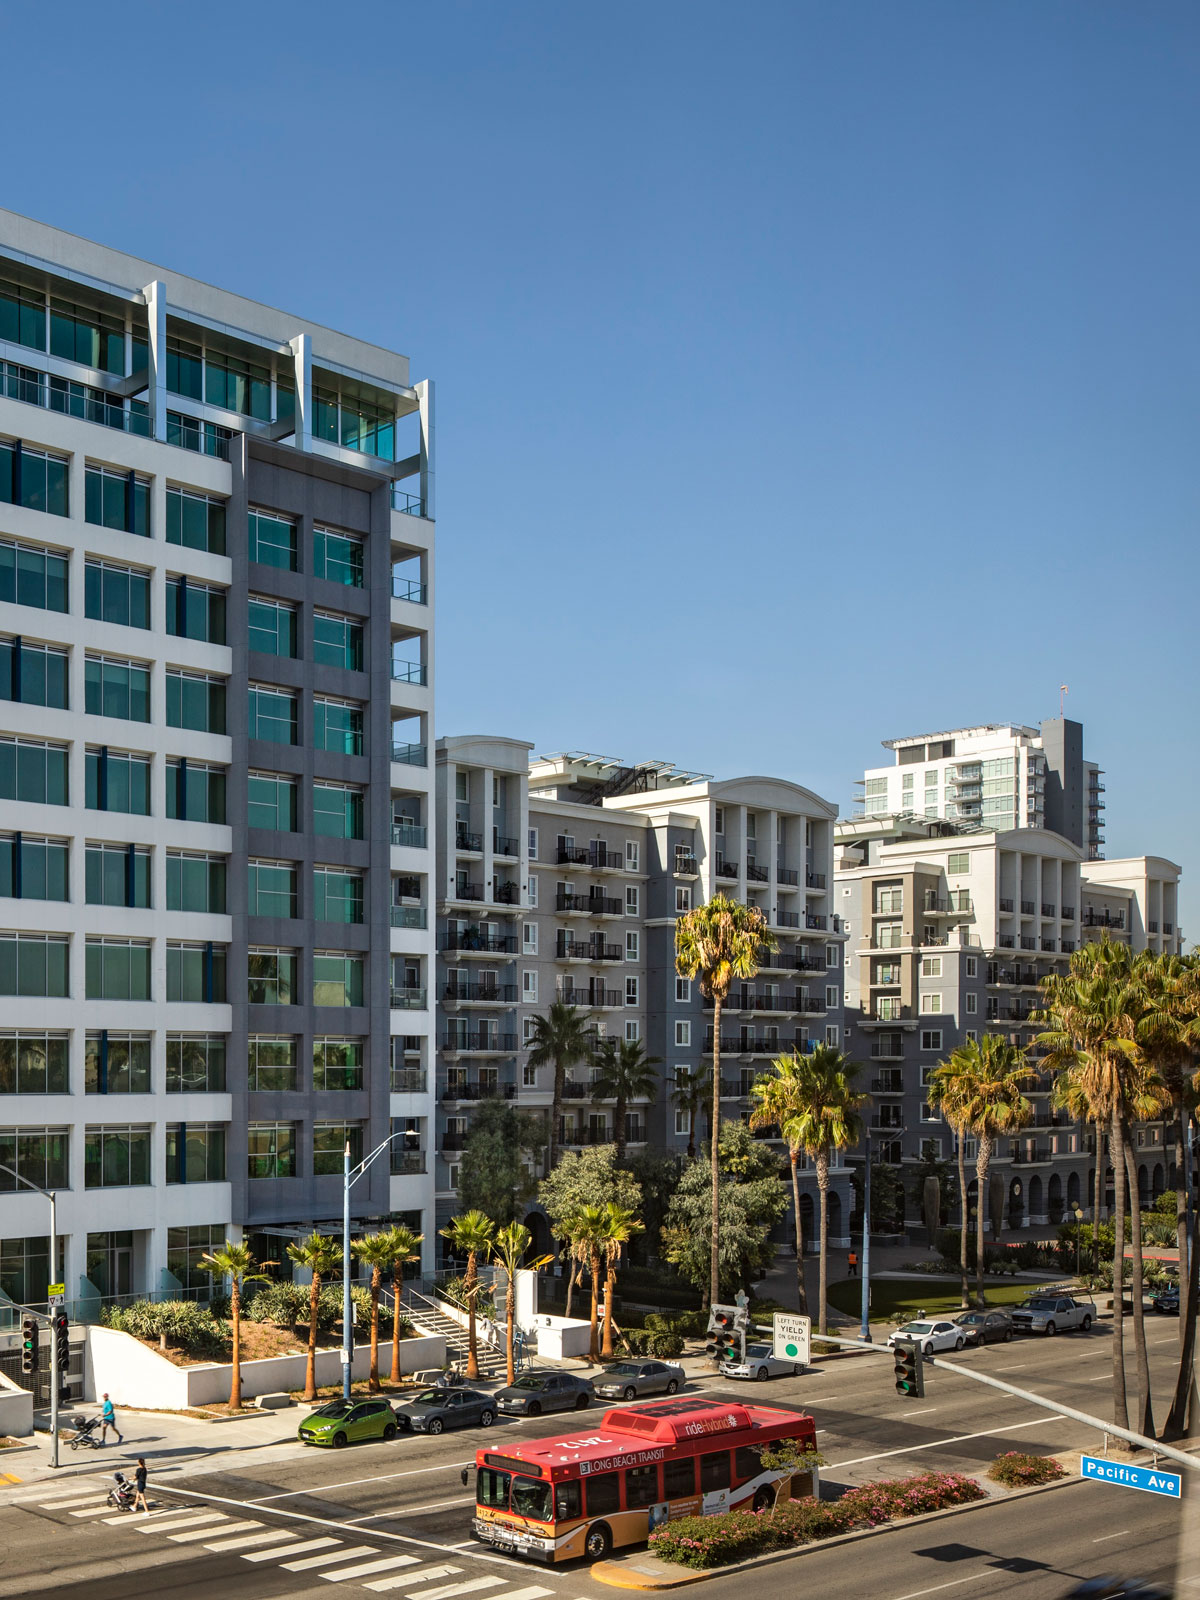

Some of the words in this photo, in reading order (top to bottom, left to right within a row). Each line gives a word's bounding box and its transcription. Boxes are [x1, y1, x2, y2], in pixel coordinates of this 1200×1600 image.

[780, 1325, 804, 1334] YIELD
[685, 1416, 730, 1436] rideHybrid
[554, 1437, 612, 1449] 2412
[590, 1459, 611, 1472] LONG
[613, 1454, 636, 1467] BEACH
[639, 1449, 664, 1463] TRANSIT
[1087, 1462, 1138, 1482] Pacific
[1148, 1476, 1175, 1491] Ave
